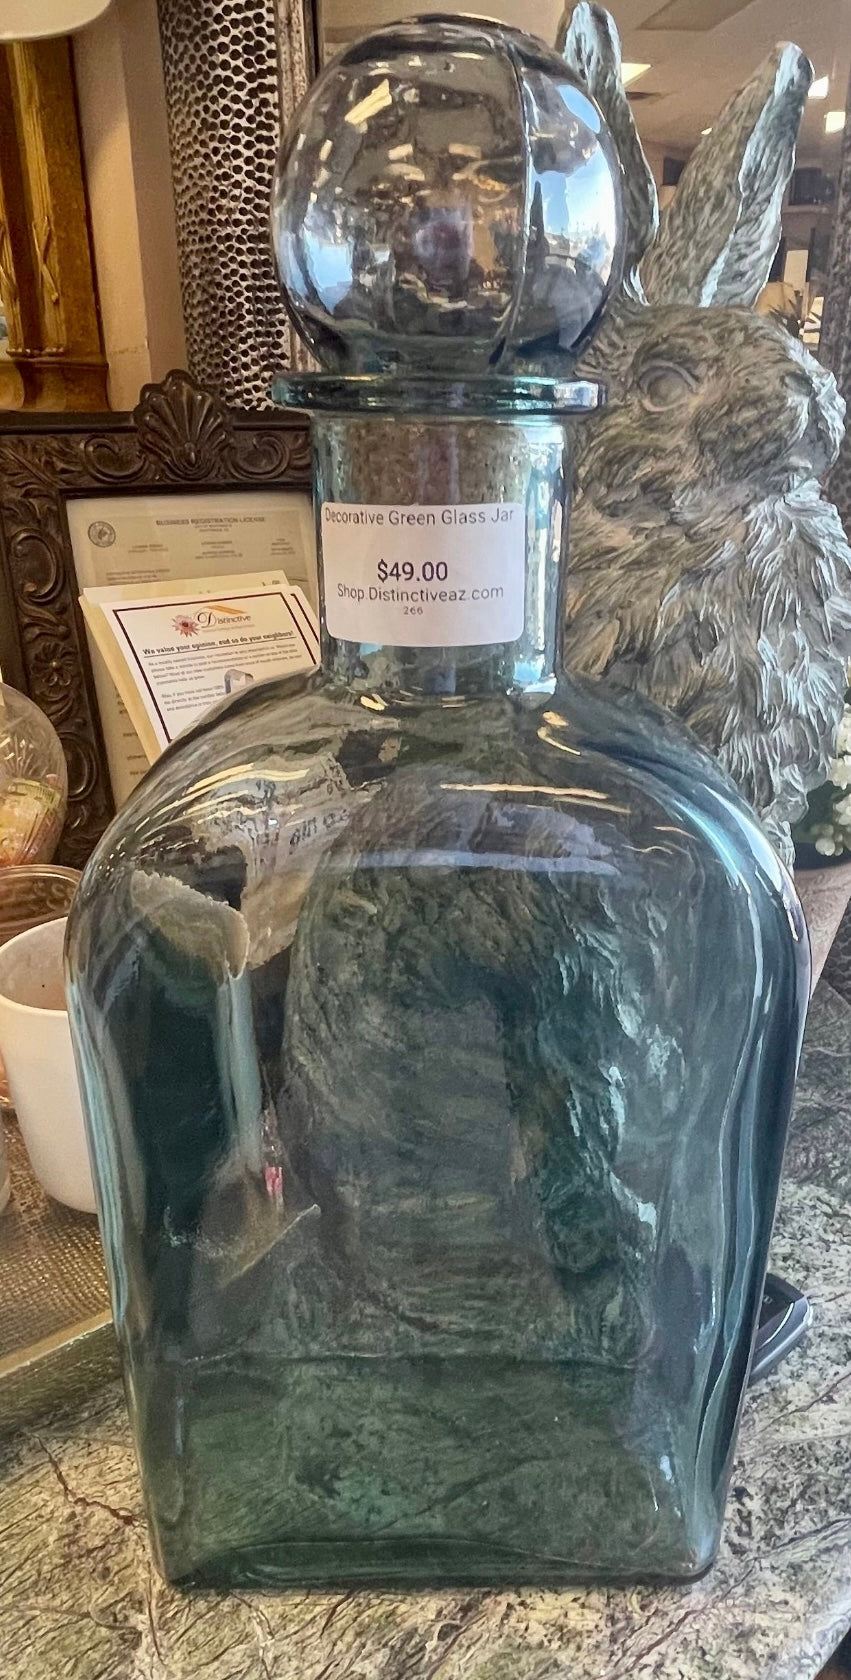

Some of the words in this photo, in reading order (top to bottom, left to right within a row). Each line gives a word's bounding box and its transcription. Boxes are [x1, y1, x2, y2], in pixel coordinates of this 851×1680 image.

[325, 507, 384, 525] Decorative
[388, 510, 436, 525] Green
[441, 508, 486, 525] Glass
[491, 507, 514, 523] Jar
[377, 559, 448, 583] $49.00
[337, 583, 504, 603] Shop.Distinctiveaz.com
[197, 611, 251, 628] Distinctive
[403, 606, 424, 615] 266
